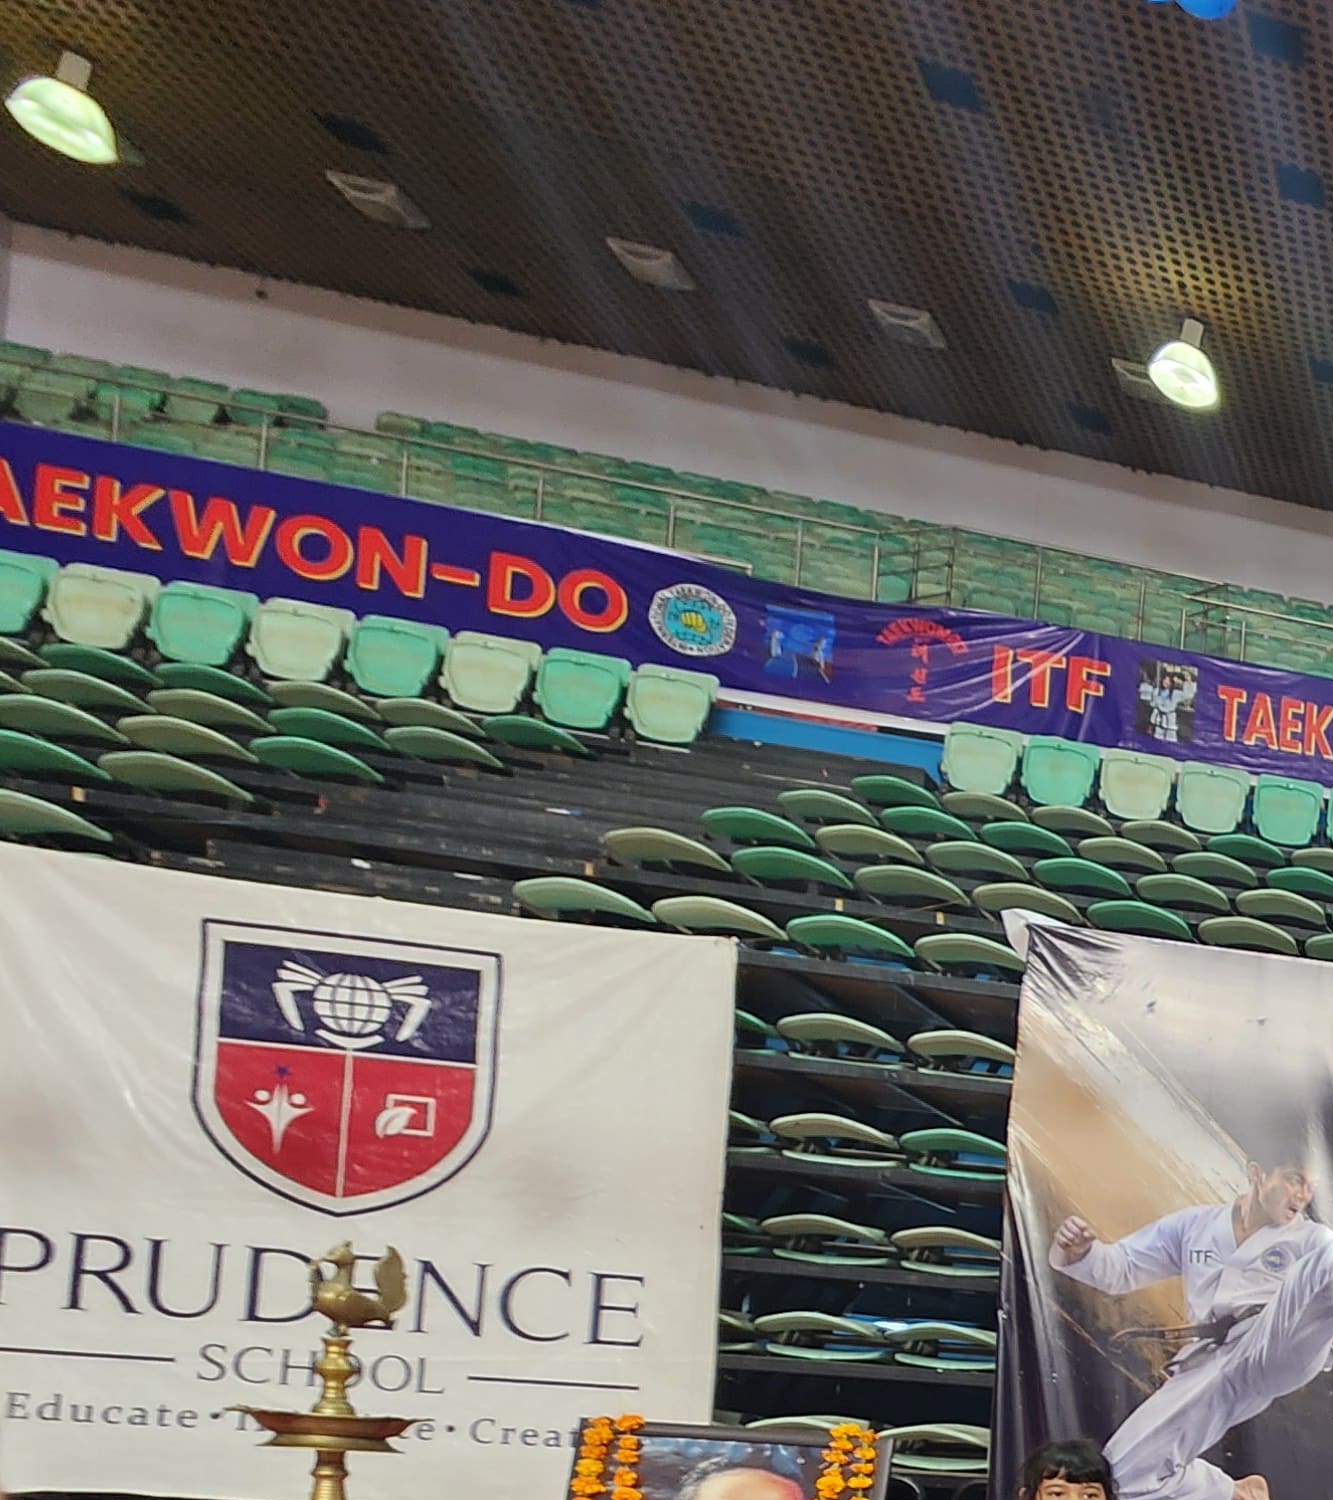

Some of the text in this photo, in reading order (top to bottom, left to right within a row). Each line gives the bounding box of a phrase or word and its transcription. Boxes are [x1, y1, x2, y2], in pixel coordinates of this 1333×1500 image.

[992, 645, 1111, 713] ITF
[1189, 1249, 1214, 1264] ITF
[6, 1391, 200, 1429] Educate
[470, 1418, 578, 1449] Creat
